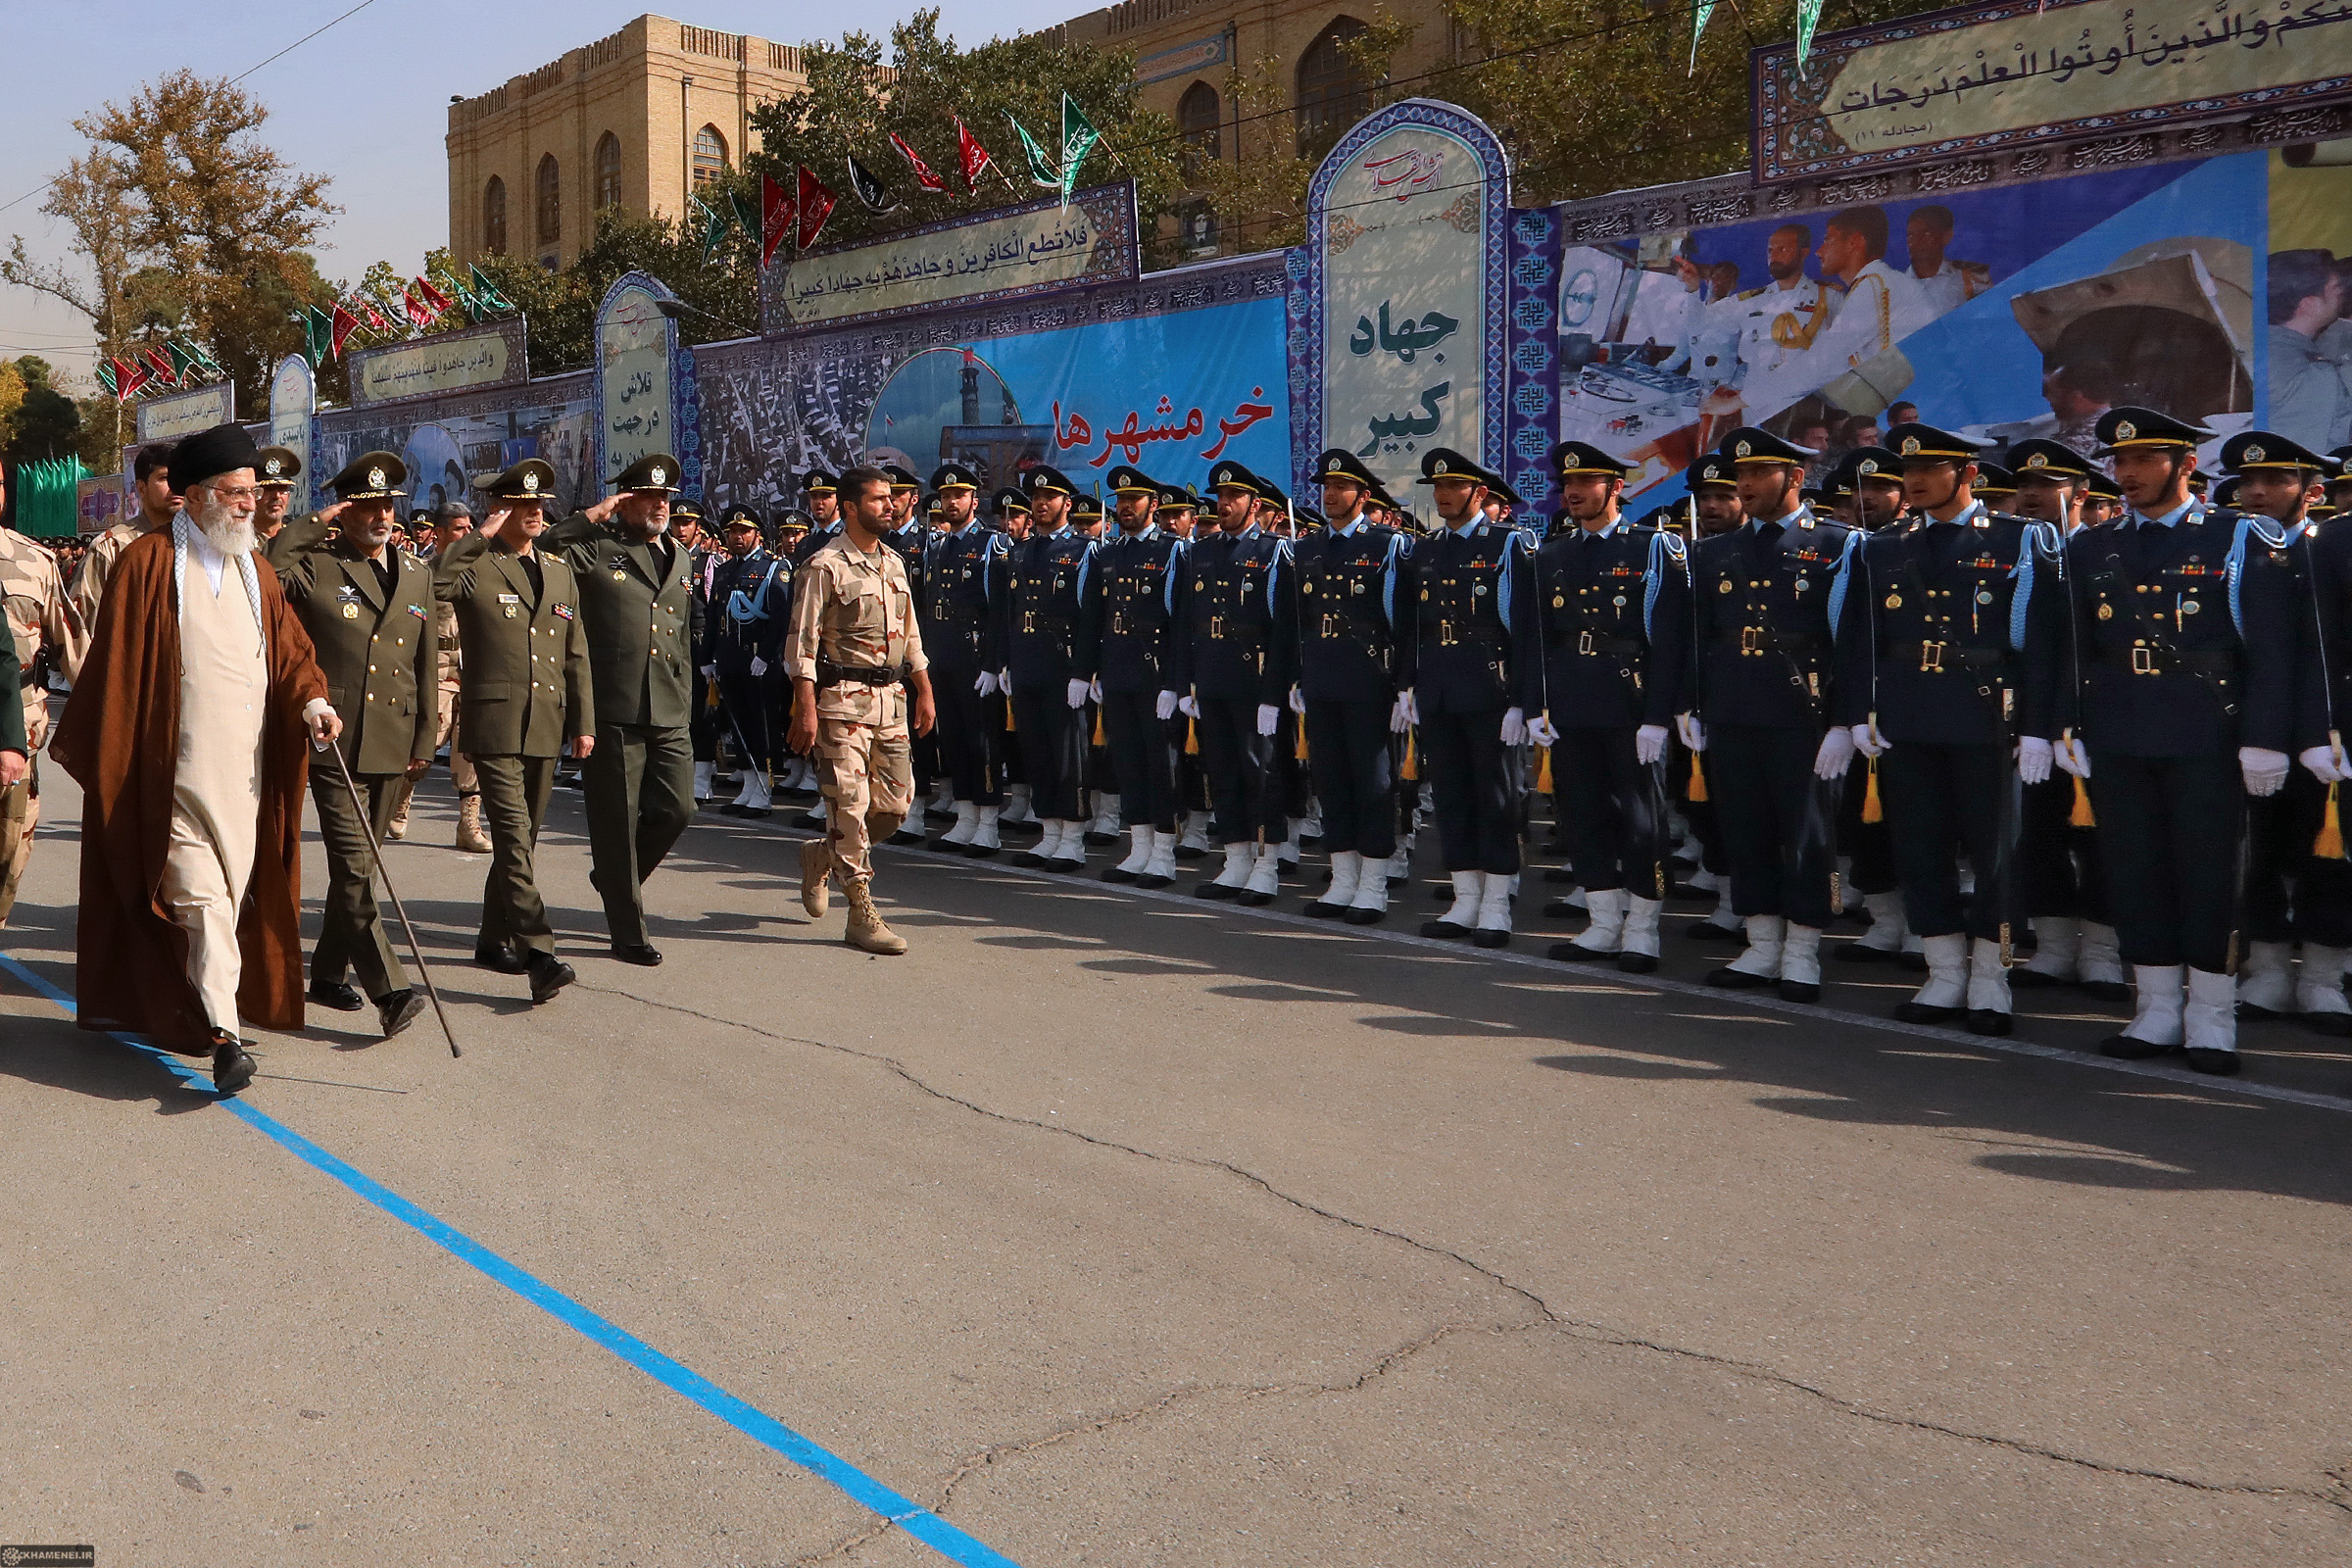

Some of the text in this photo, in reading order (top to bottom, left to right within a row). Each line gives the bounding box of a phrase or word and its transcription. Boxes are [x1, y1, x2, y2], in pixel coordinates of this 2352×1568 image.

[1348, 298, 1461, 365] جهاد
[620, 370, 652, 404] تلاش
[612, 410, 661, 437] در جهت
[1356, 380, 1451, 459] کبیر
[610, 451, 622, 472] به
